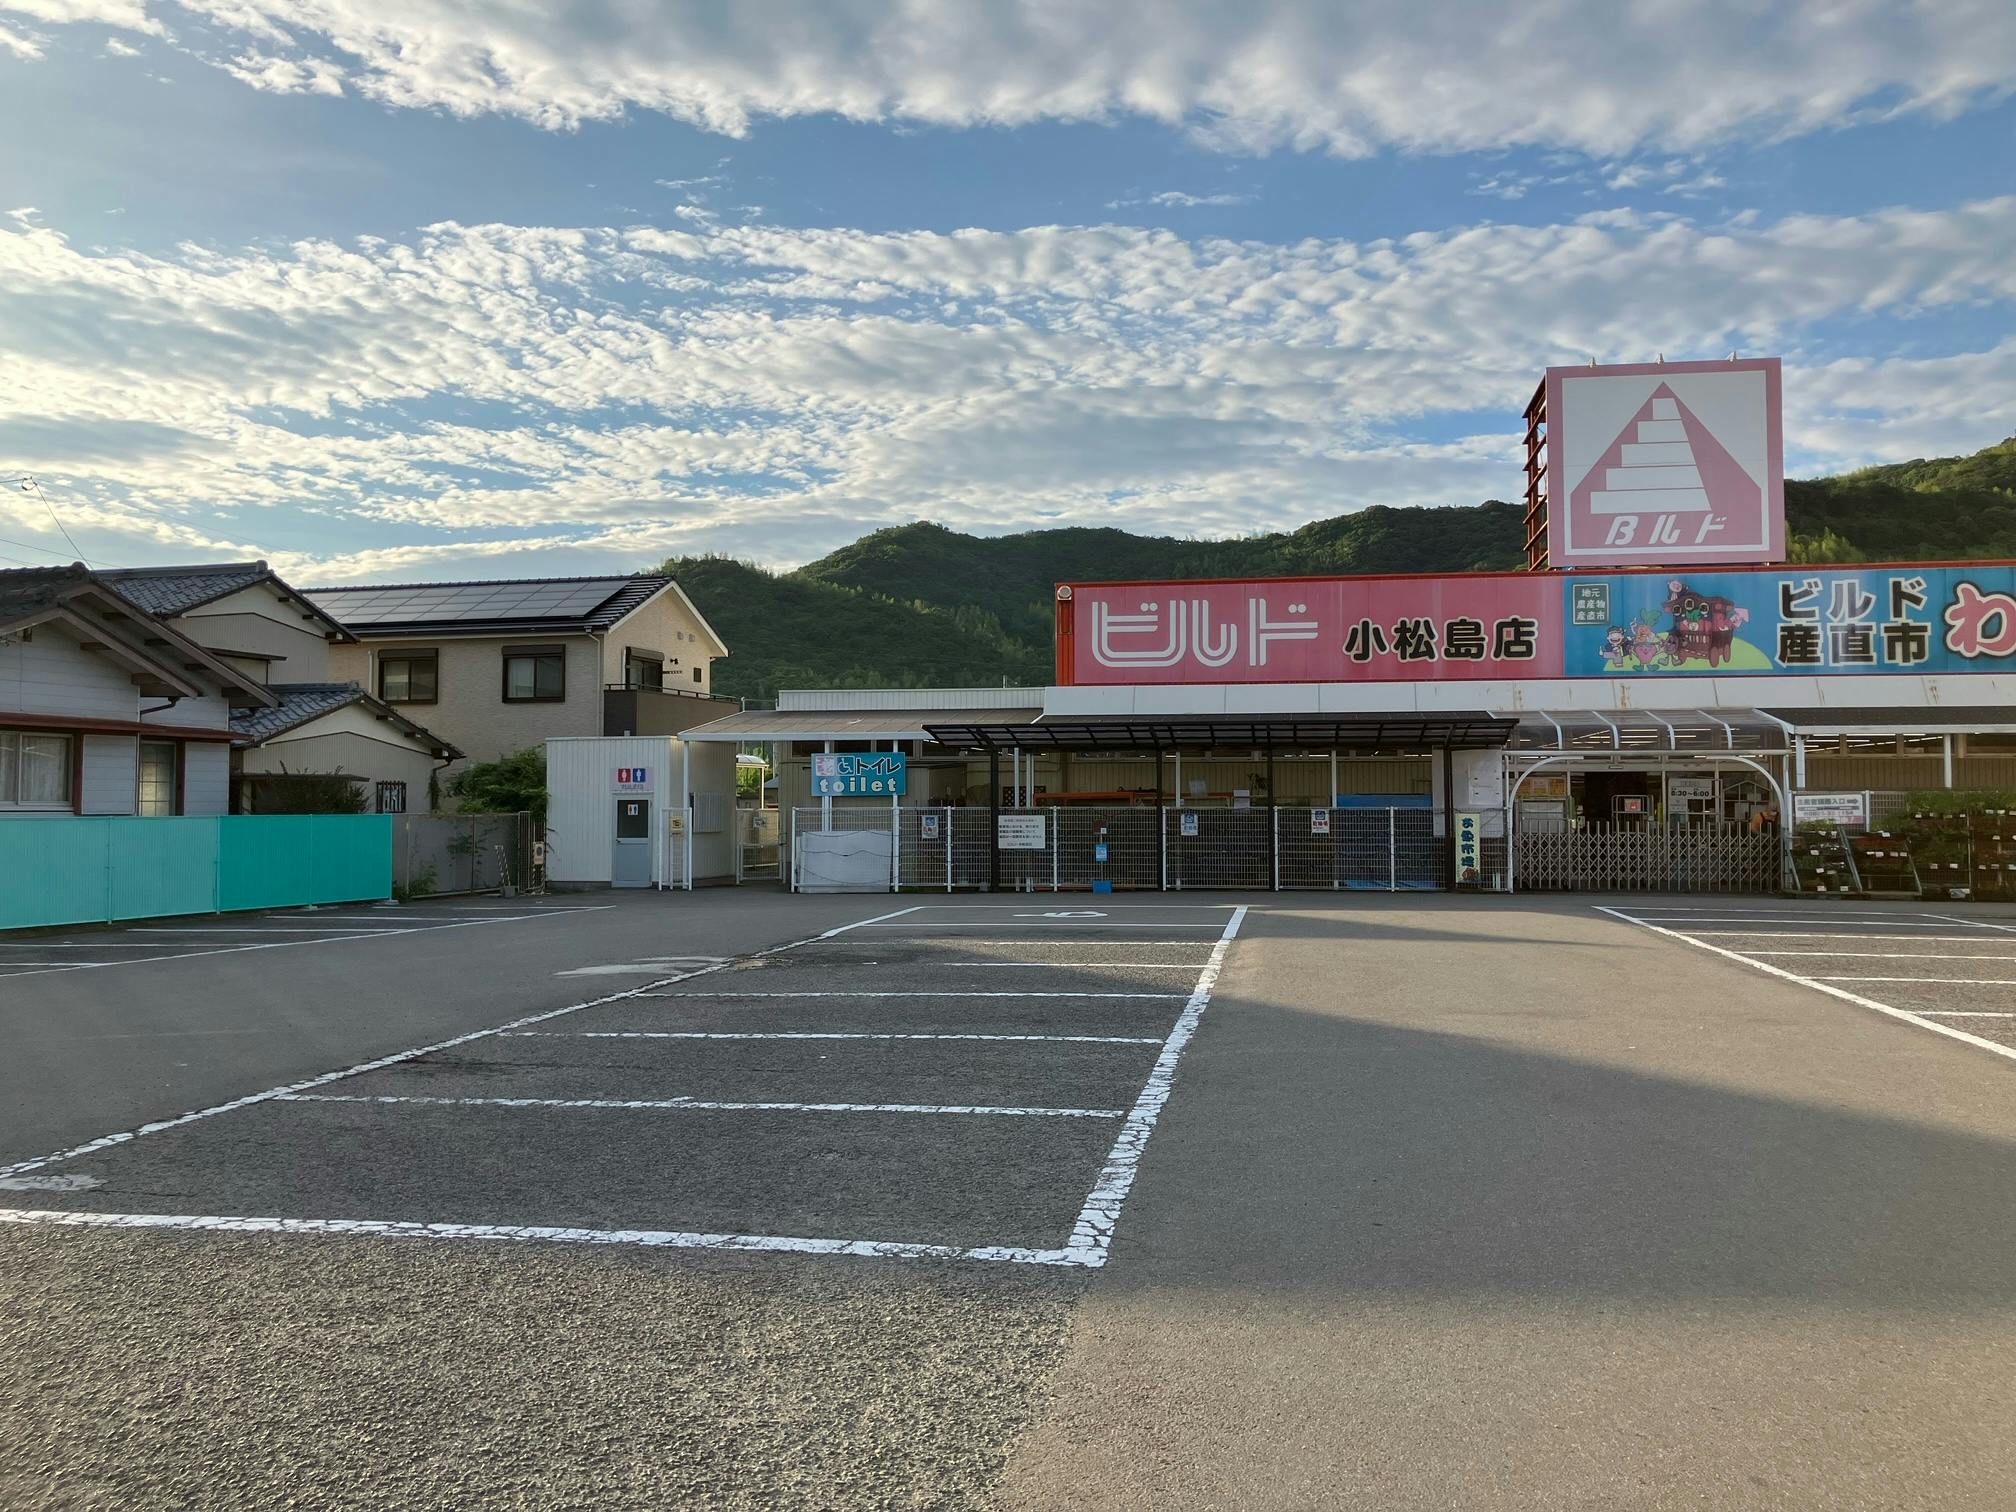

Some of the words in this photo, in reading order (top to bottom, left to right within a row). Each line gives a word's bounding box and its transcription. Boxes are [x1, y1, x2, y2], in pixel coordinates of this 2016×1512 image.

[1581, 588, 1601, 598] 地元
[1778, 576, 1928, 622] ビルド
[1576, 599, 1606, 609] 農産物
[1576, 611, 1606, 621] 産直市
[1092, 598, 1319, 668] ビルド
[1342, 614, 1538, 664] 小松島店
[1775, 620, 1932, 668] 産直市
[855, 757, 901, 775] トイレ
[820, 777, 896, 792] toilet
[1461, 817, 1475, 867] お魚市場
